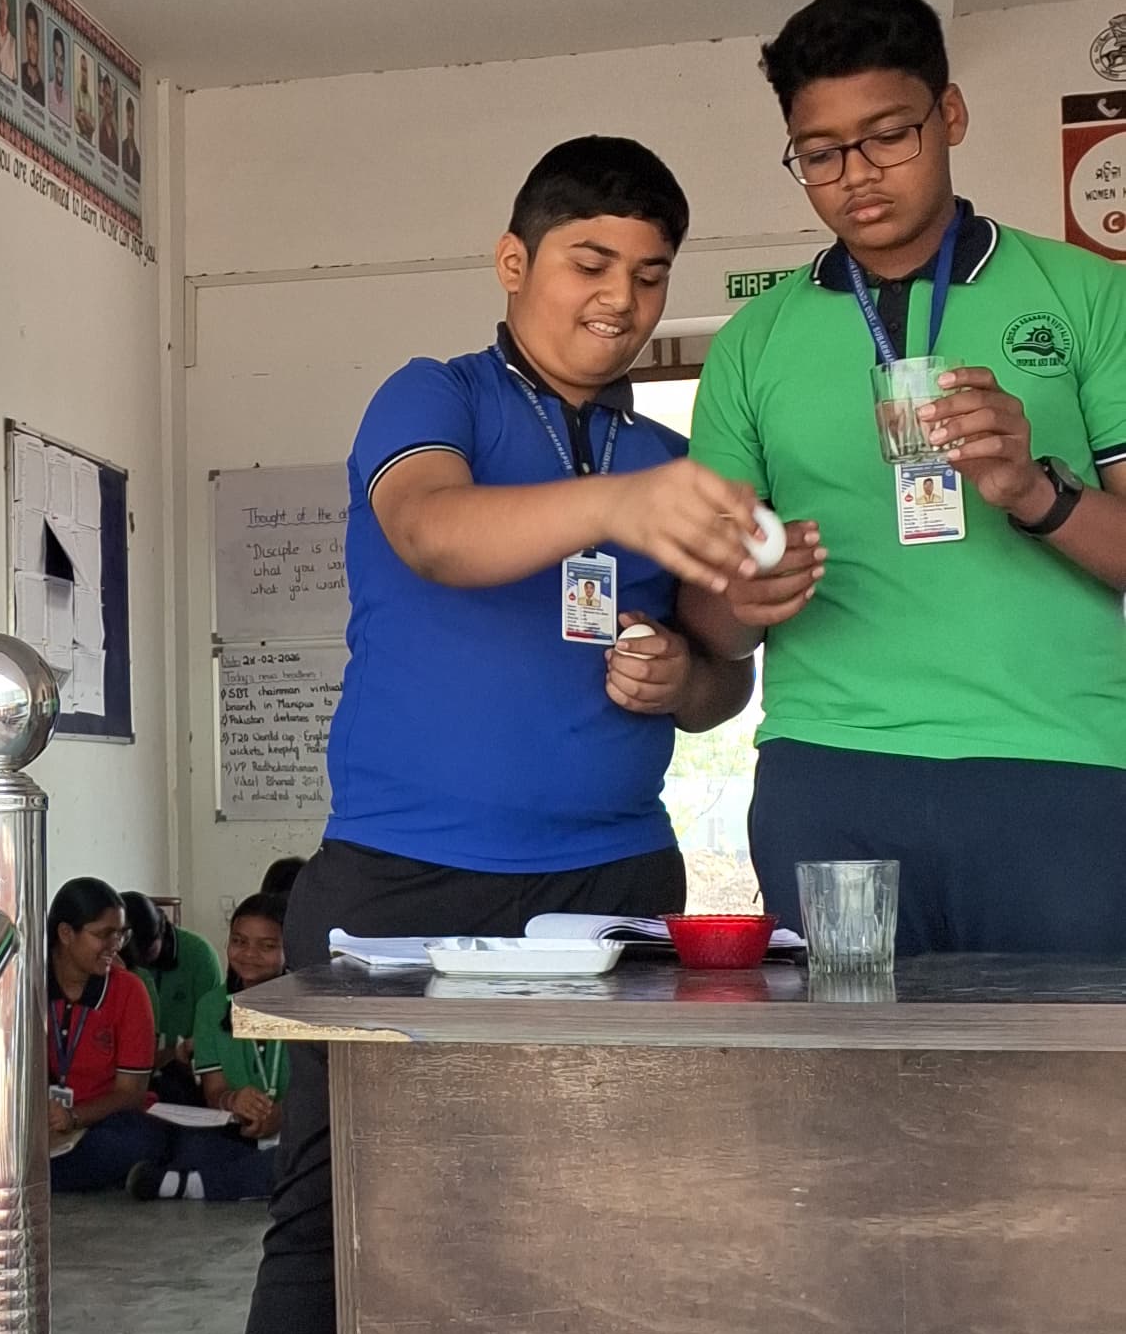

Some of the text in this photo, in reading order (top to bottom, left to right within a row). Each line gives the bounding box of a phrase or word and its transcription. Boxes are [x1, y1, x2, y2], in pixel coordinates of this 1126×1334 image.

[13, 158, 27, 184] are
[1084, 187, 1116, 202] WOMEN
[730, 272, 771, 297] FIRE
[242, 506, 347, 529] Thought of the d
[311, 543, 322, 554] is
[253, 561, 282, 577] what
[294, 564, 315, 583] you
[250, 574, 346, 601] what you want
[263, 700, 273, 709] in
[303, 728, 330, 747] Engla
